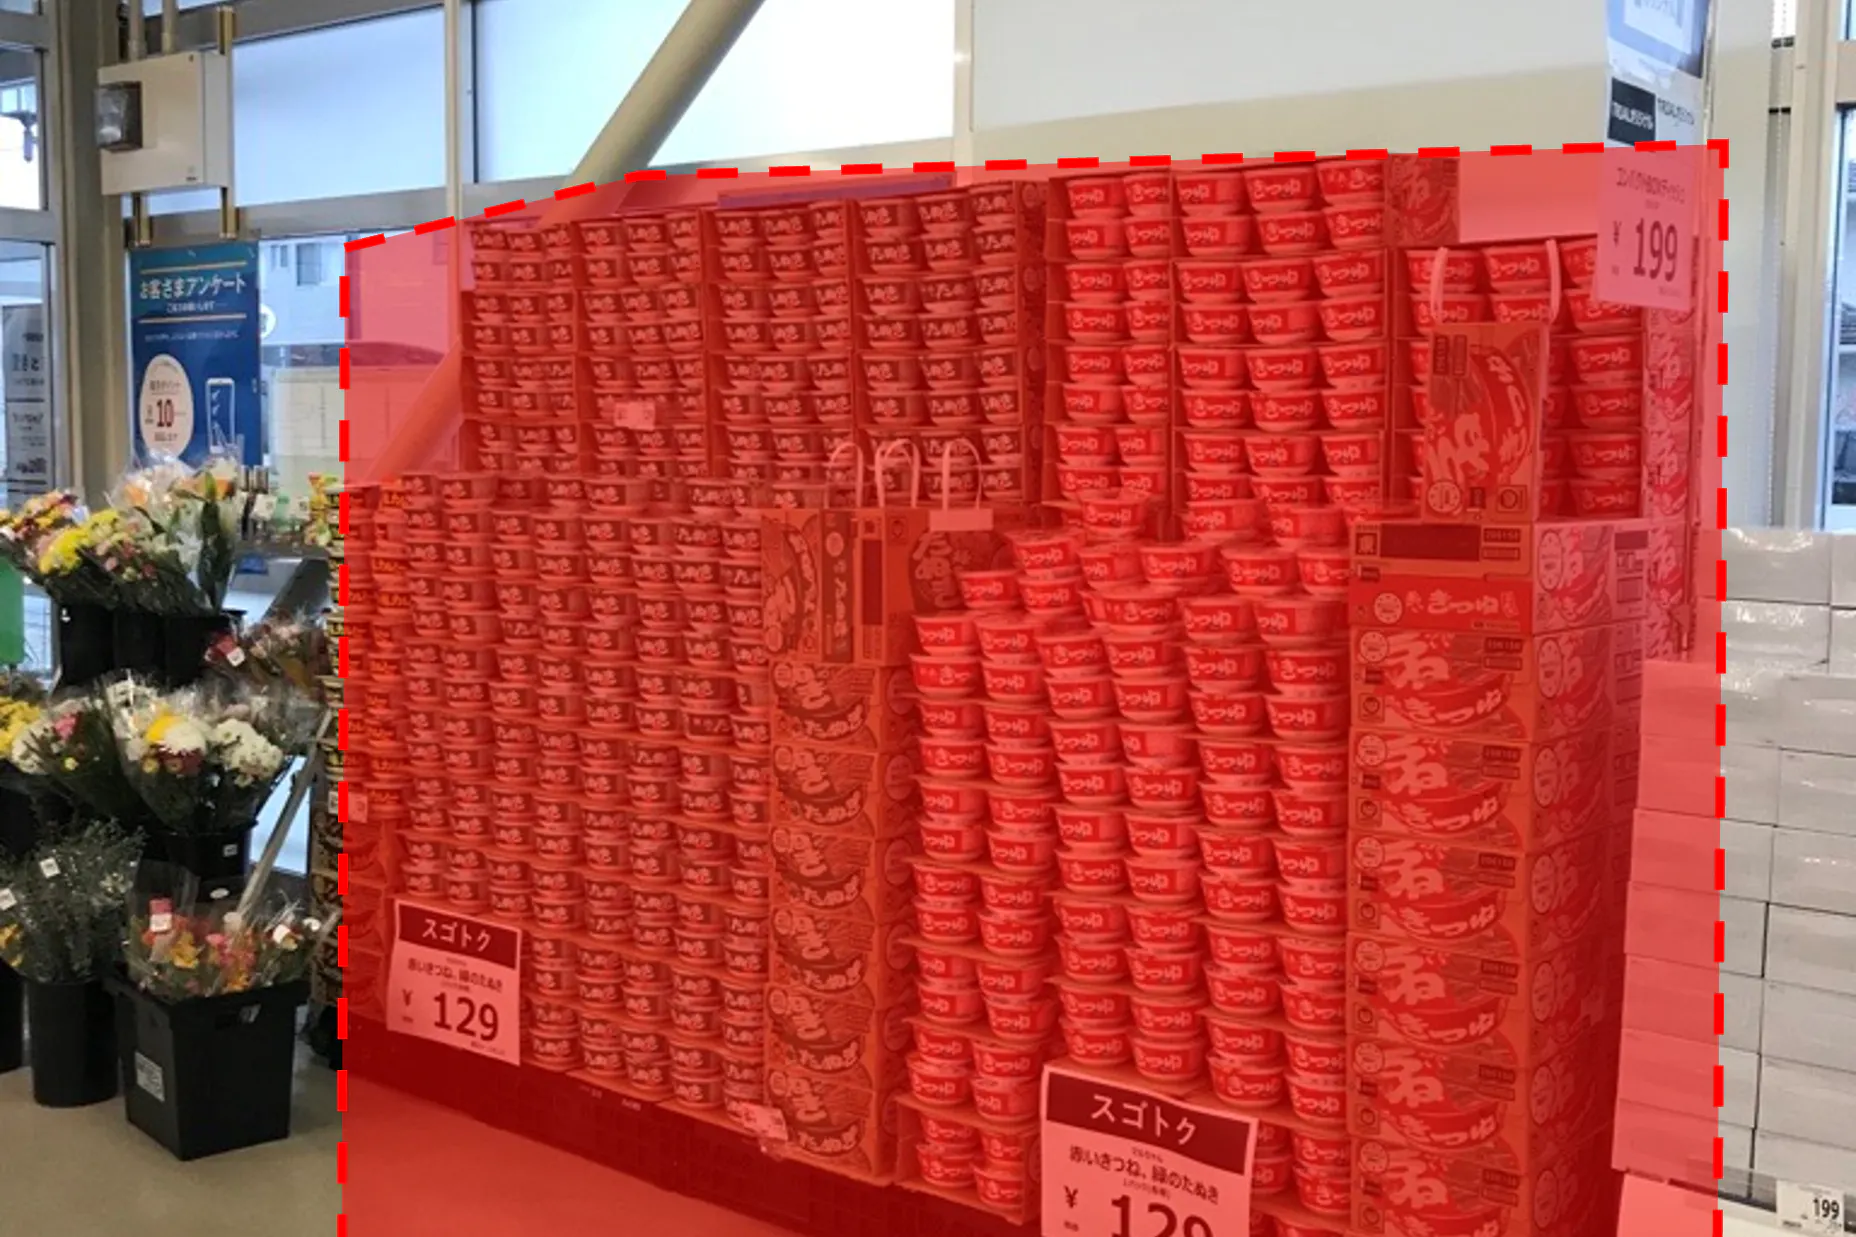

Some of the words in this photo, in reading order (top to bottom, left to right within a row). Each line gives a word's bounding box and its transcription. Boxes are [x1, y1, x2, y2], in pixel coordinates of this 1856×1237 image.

[1633, 218, 1678, 282] 199
[156, 398, 174, 428] 10
[422, 918, 492, 953] スゴトク
[432, 991, 500, 1043] 129
[1091, 1093, 1198, 1146] スゴトク
[1813, 1197, 1840, 1220] 199
